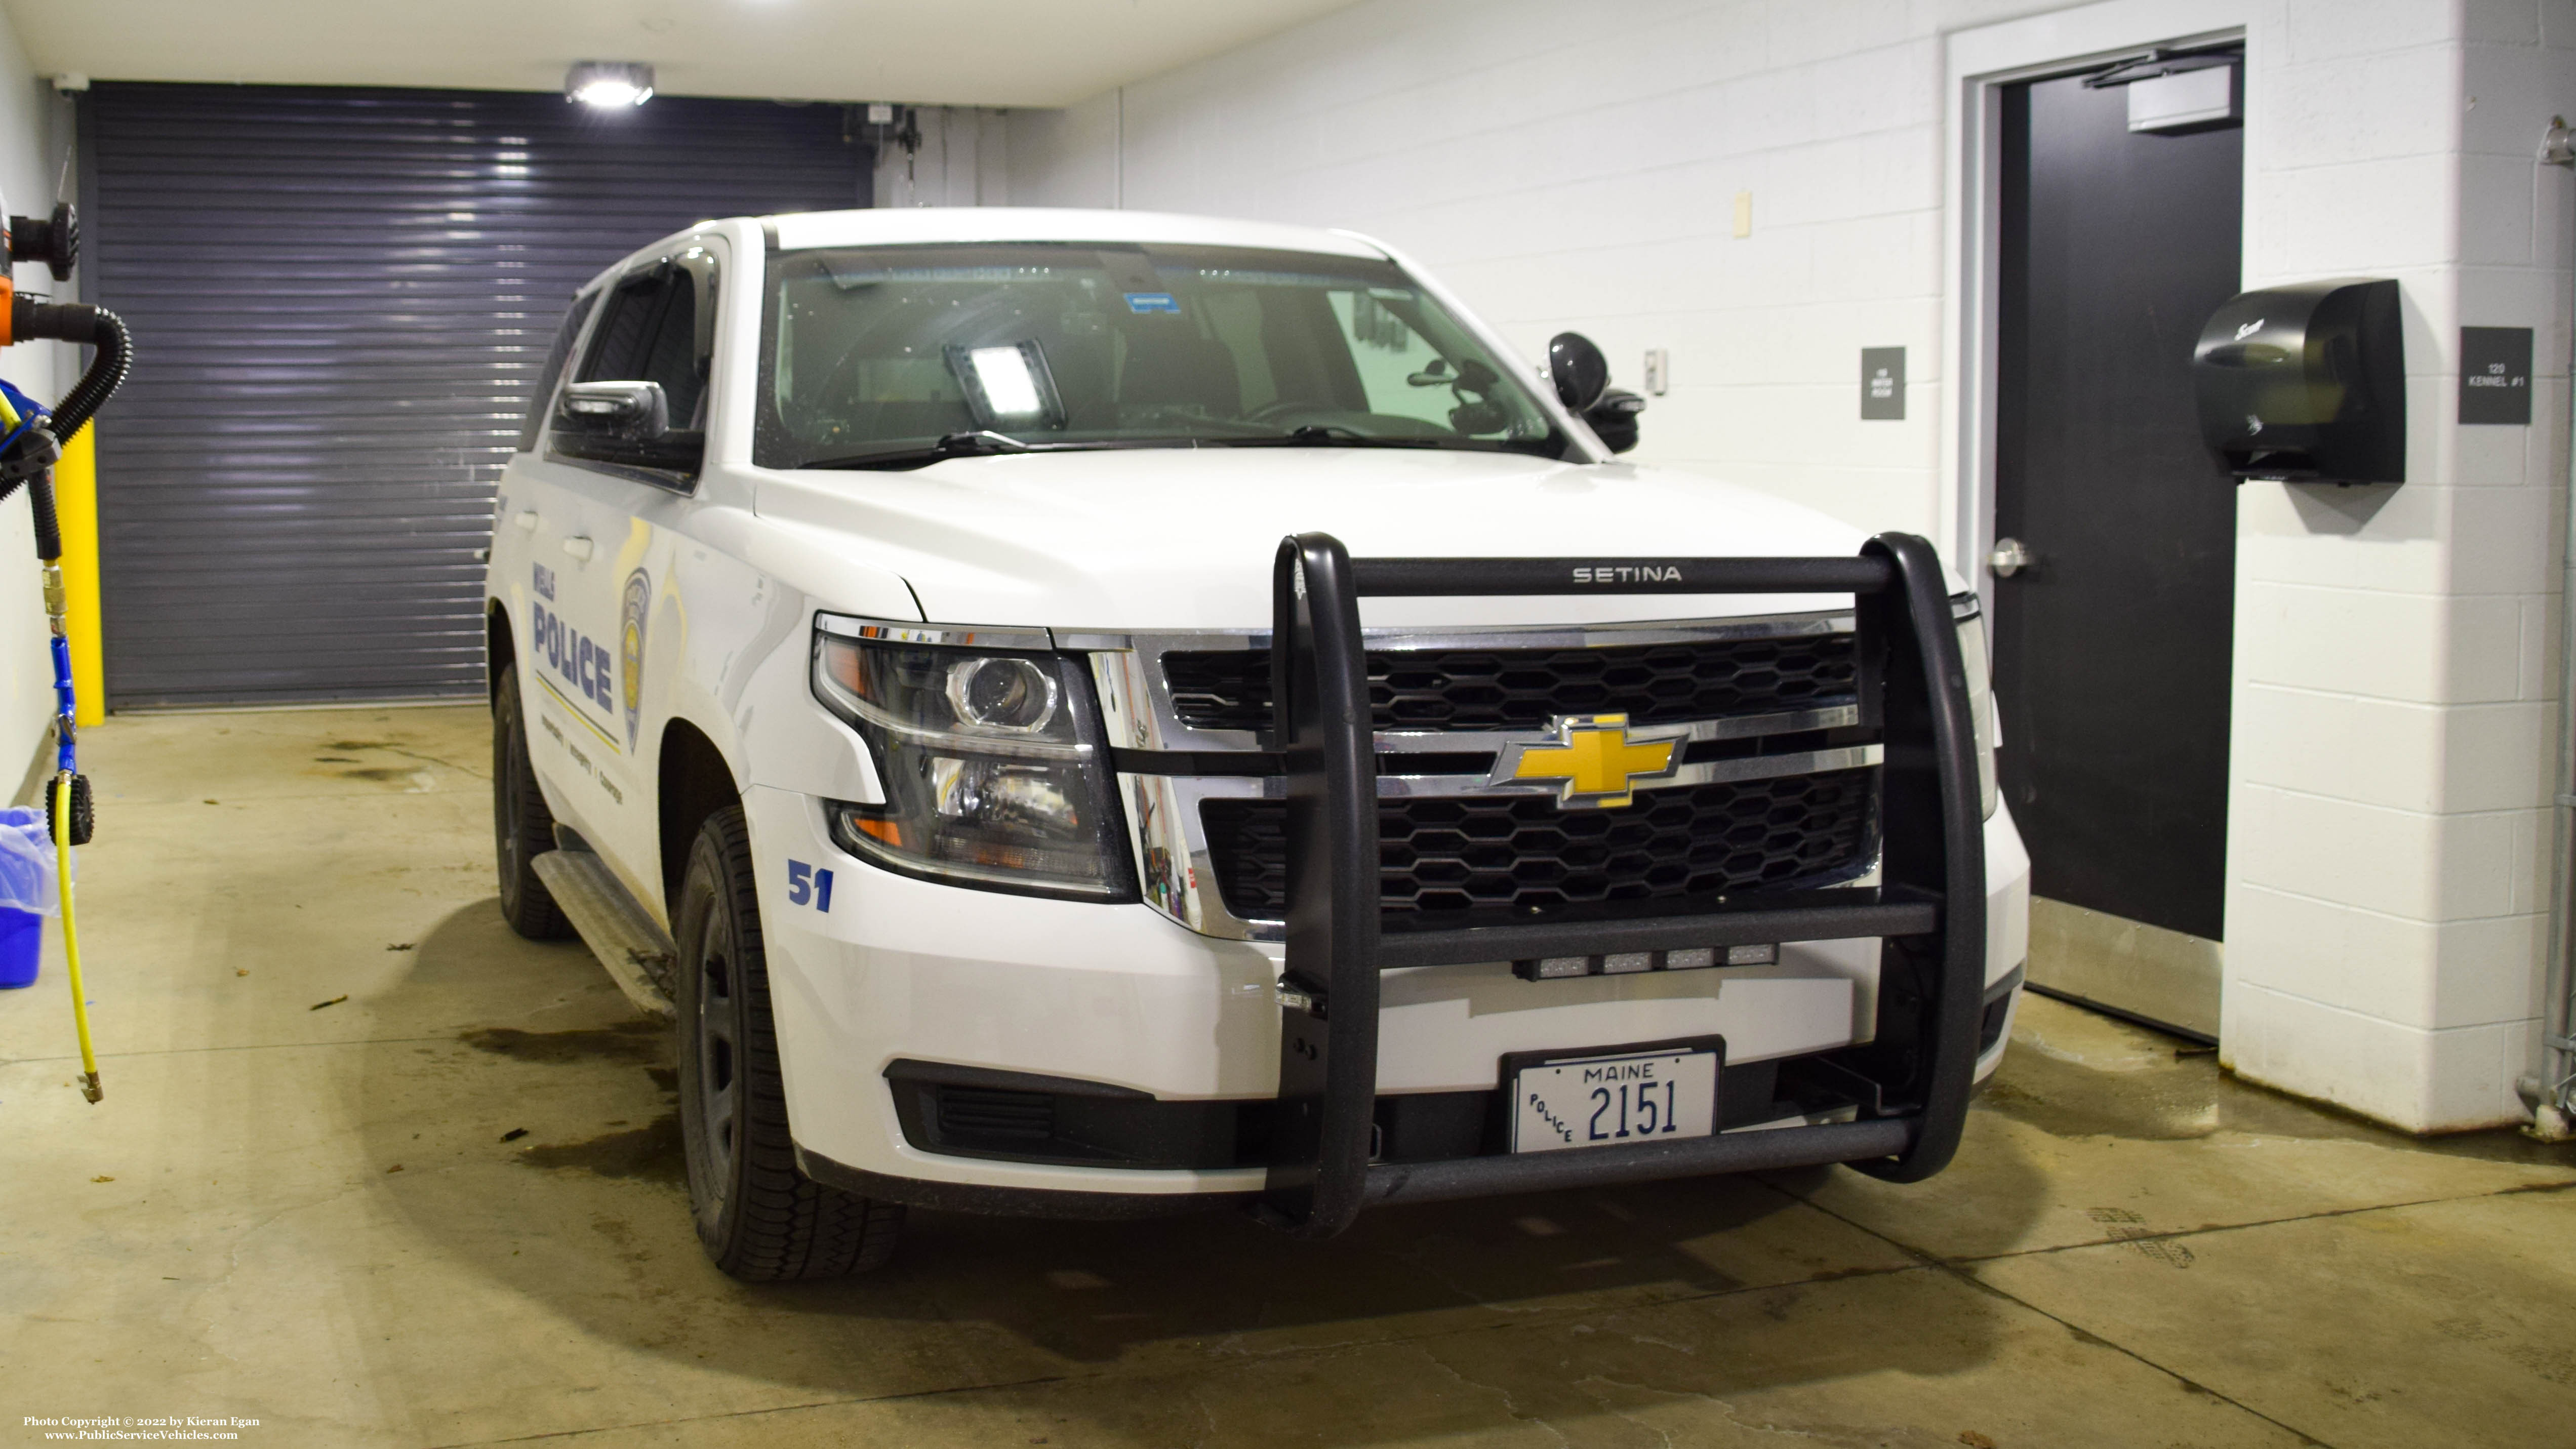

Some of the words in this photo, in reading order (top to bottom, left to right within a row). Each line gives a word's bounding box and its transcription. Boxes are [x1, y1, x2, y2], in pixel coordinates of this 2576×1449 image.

[2468, 376, 2507, 387] KENNEL
[1573, 566, 1682, 582] SETINA
[534, 600, 613, 714] POLICE
[788, 858, 834, 913] 51
[1584, 1063, 1655, 1083] MAINE
[1530, 1093, 1572, 1142] POLICE
[1588, 1080, 1676, 1140] 2151
